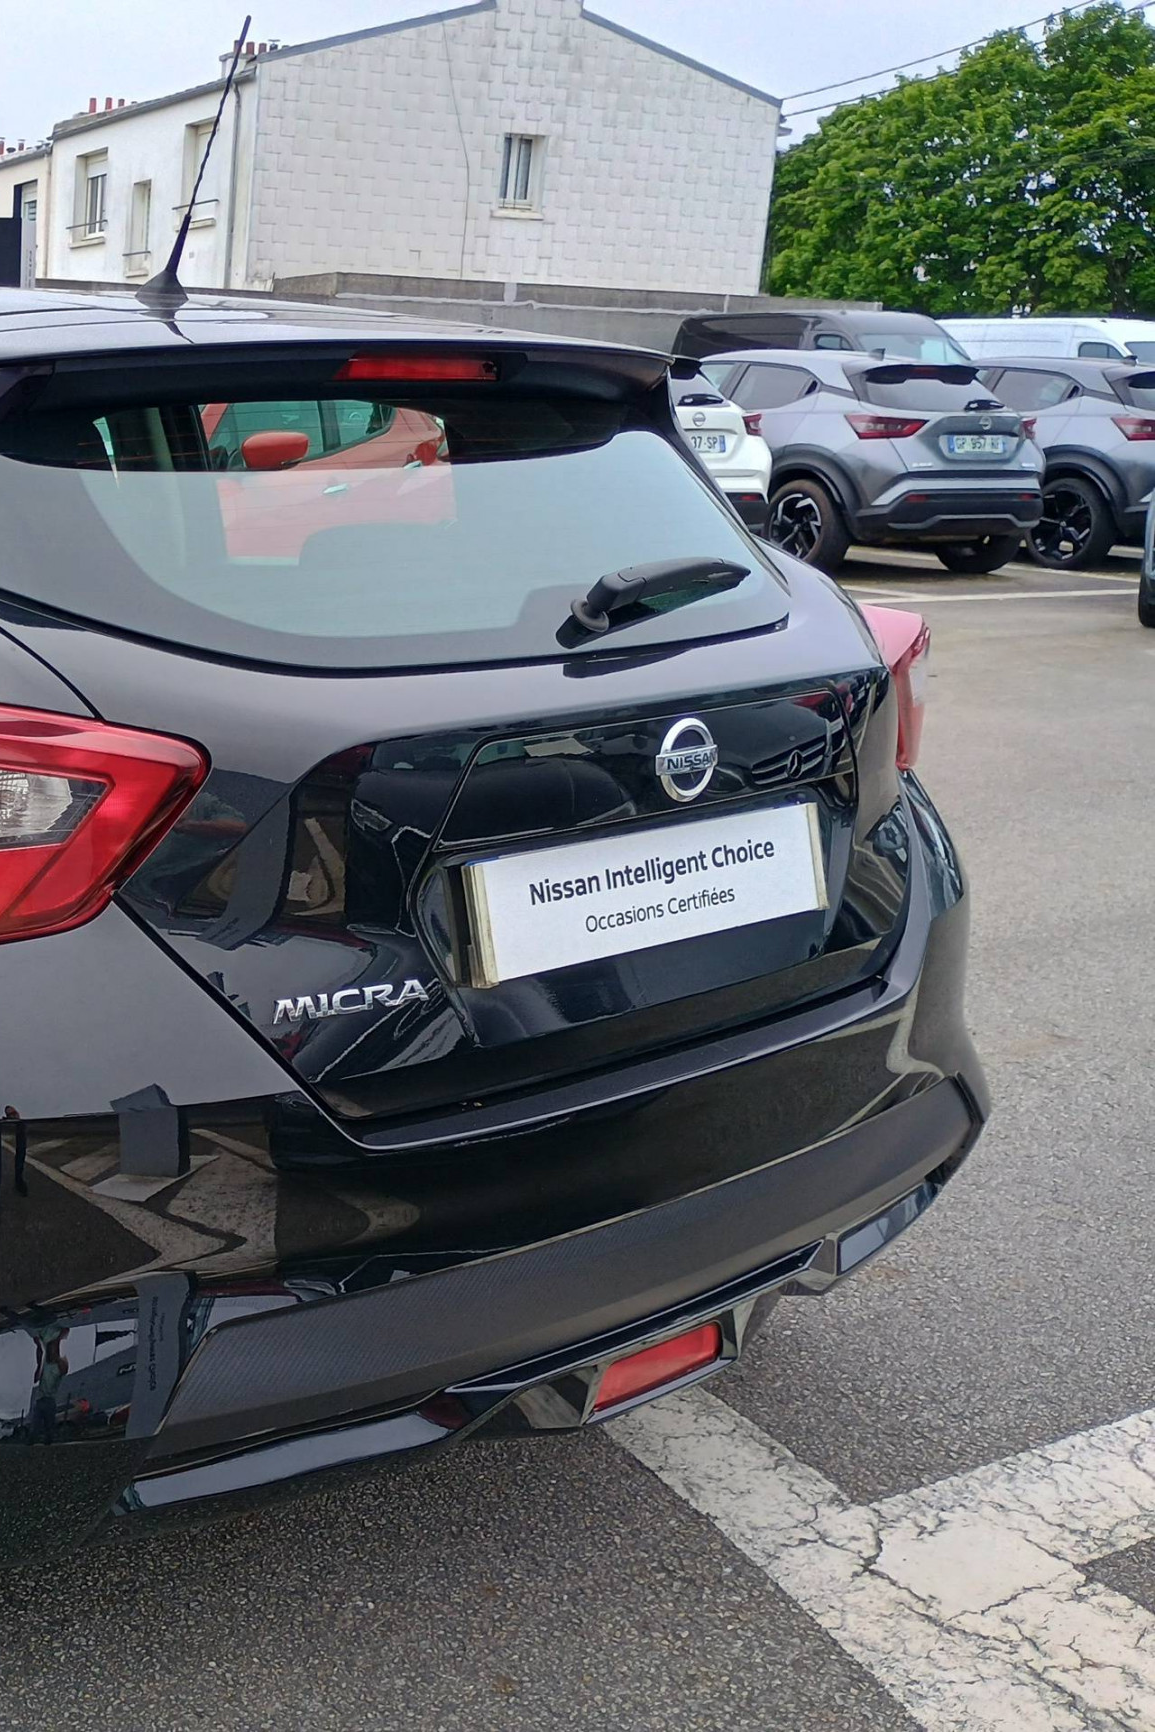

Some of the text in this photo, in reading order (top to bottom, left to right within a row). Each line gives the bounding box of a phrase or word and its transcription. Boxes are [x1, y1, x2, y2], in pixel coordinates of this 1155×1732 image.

[667, 750, 715, 771] NISSAN
[529, 837, 776, 906] Nissan Intelligent Choice
[584, 886, 736, 933] Occasions Certifiées
[272, 979, 430, 1026] MICRA
